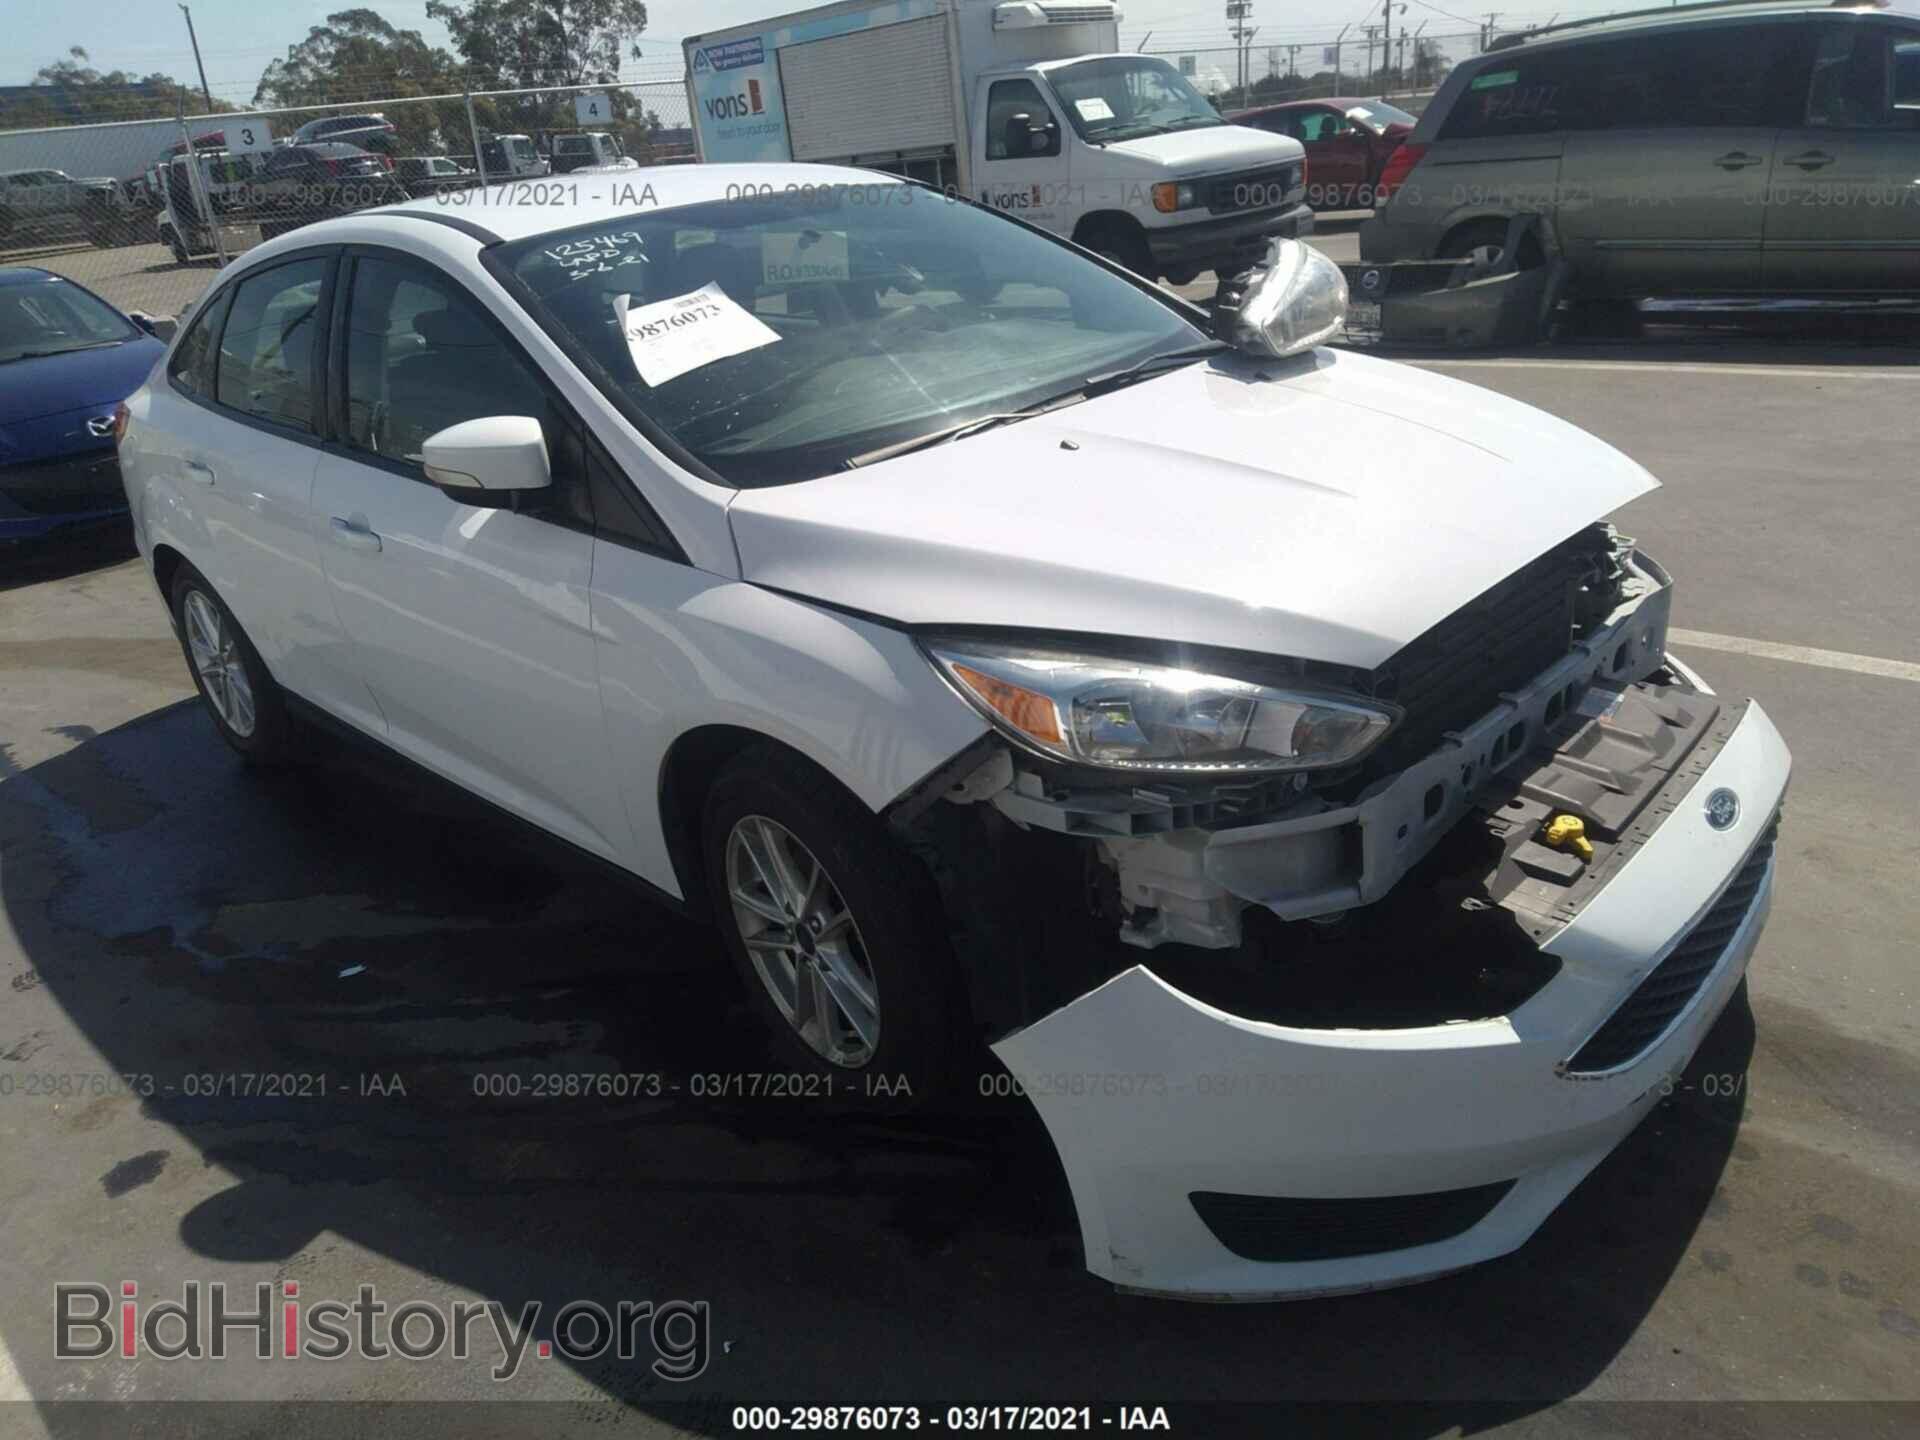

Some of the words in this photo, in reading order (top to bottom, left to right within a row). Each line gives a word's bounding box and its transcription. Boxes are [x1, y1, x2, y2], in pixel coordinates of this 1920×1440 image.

[588, 103, 599, 118] 4
[705, 94, 748, 120] vons
[241, 128, 256, 146] 3
[992, 192, 1029, 208] vons
